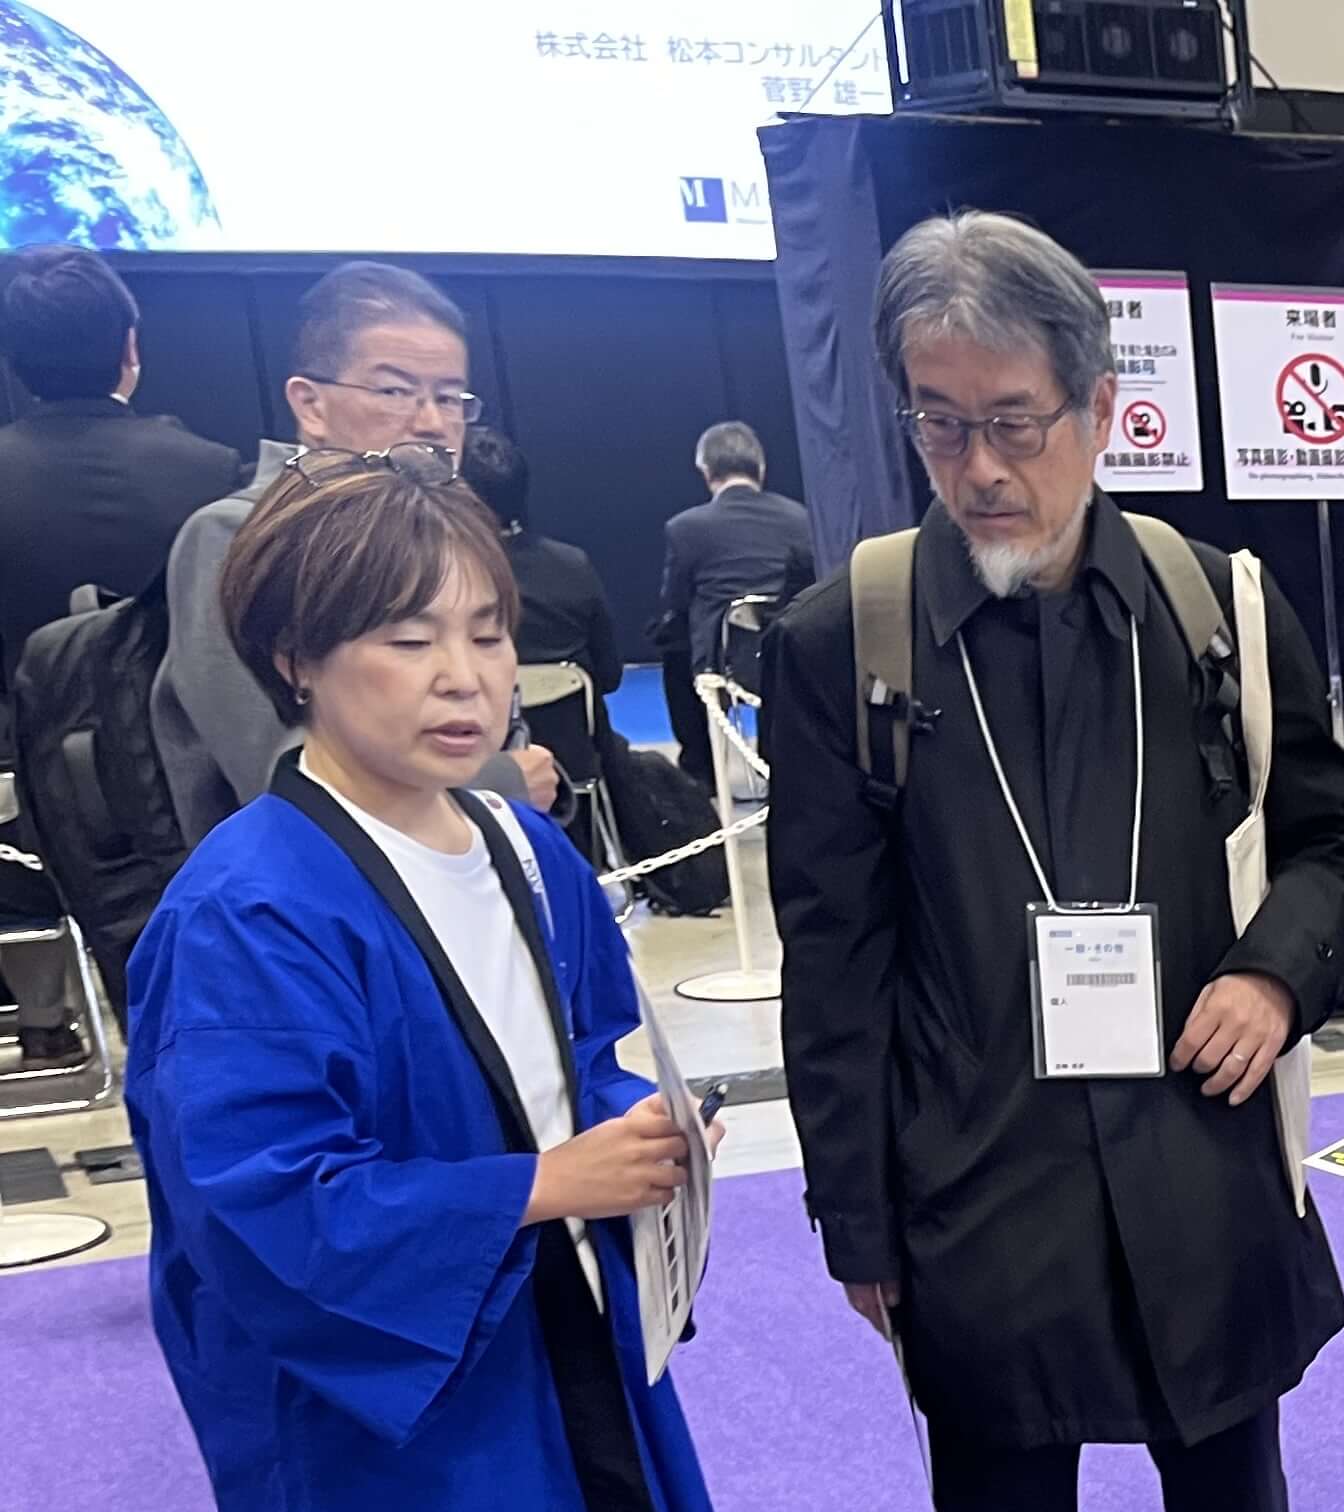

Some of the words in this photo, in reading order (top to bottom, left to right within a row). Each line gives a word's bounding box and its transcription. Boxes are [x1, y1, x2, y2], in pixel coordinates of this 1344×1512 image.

[535, 30, 648, 63] 株式会社
[667, 36, 882, 72] 松本コンサルタント
[761, 75, 813, 103] 菅野
[833, 79, 885, 106] 雄一
[1285, 309, 1337, 329] 来場者
[1103, 453, 1190, 467] 動画撮影禁止
